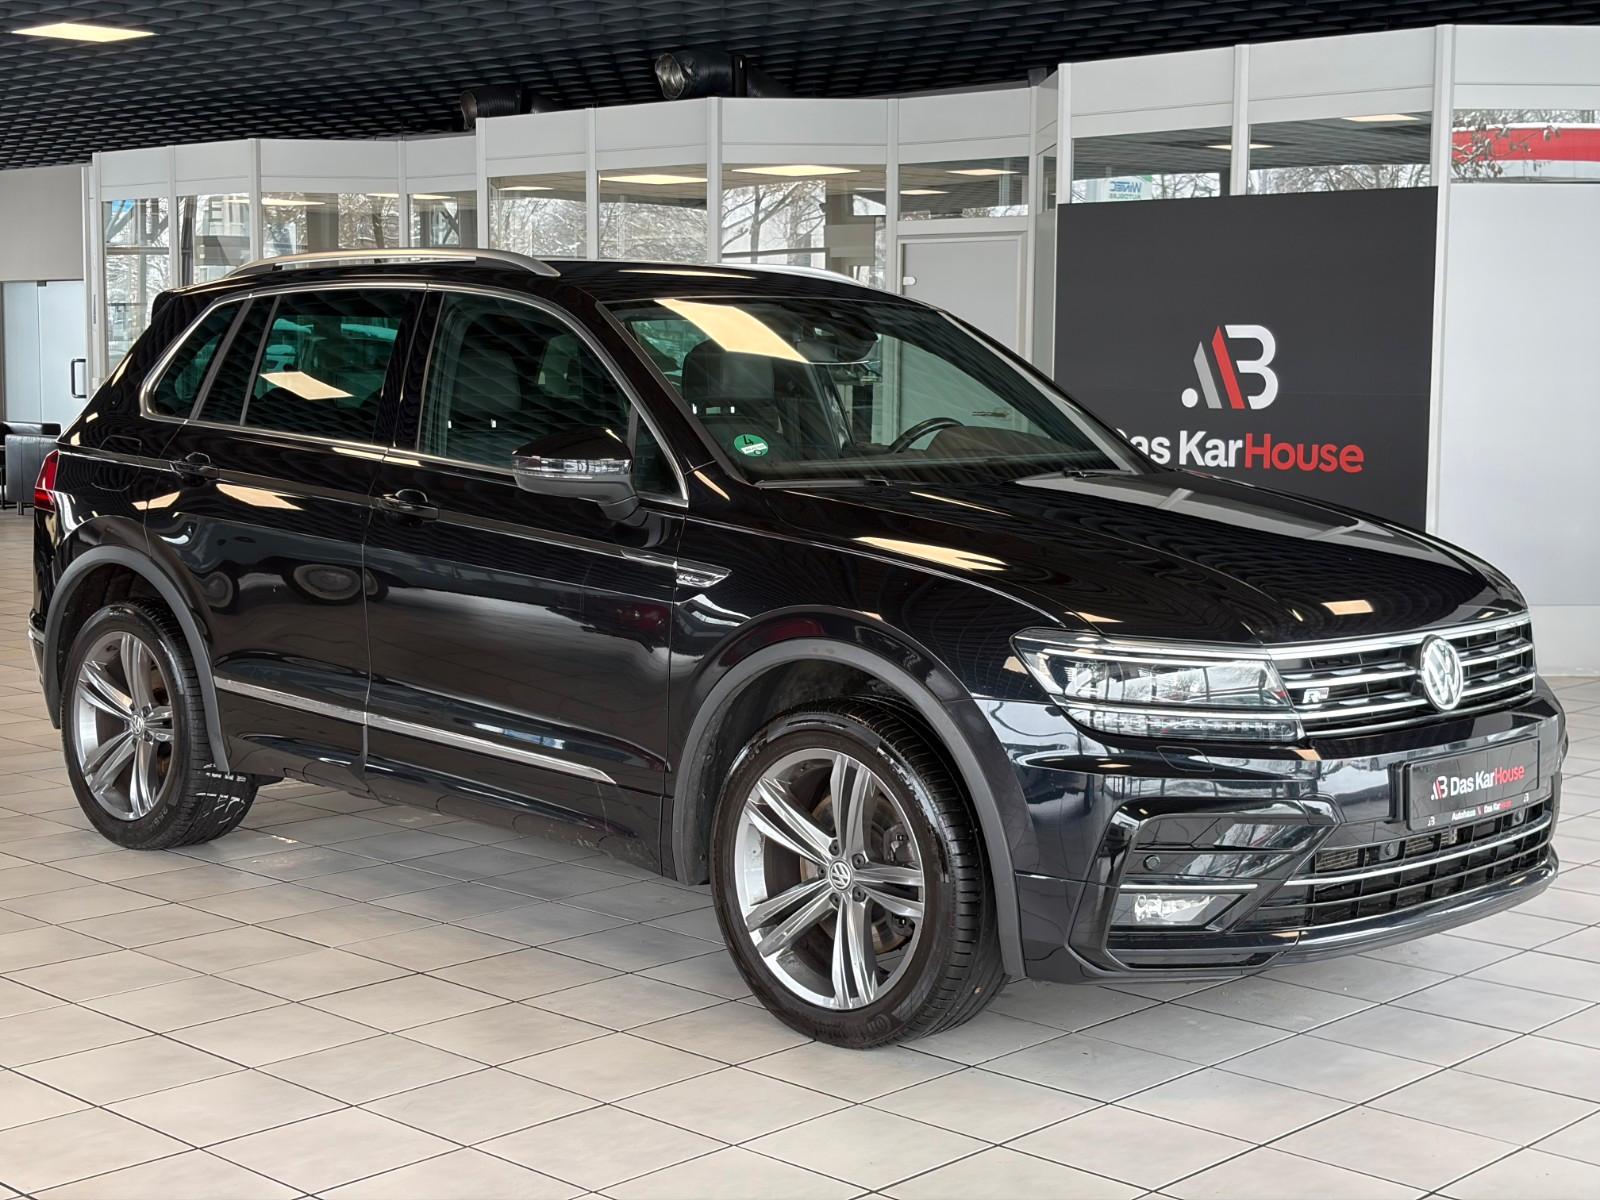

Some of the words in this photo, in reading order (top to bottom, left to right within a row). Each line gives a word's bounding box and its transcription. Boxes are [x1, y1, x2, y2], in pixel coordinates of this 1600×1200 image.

[1115, 427, 1171, 464] as
[1179, 430, 1364, 472] KarHouse
[1450, 776, 1474, 796] Das
[1475, 766, 1524, 791] KarHouse
